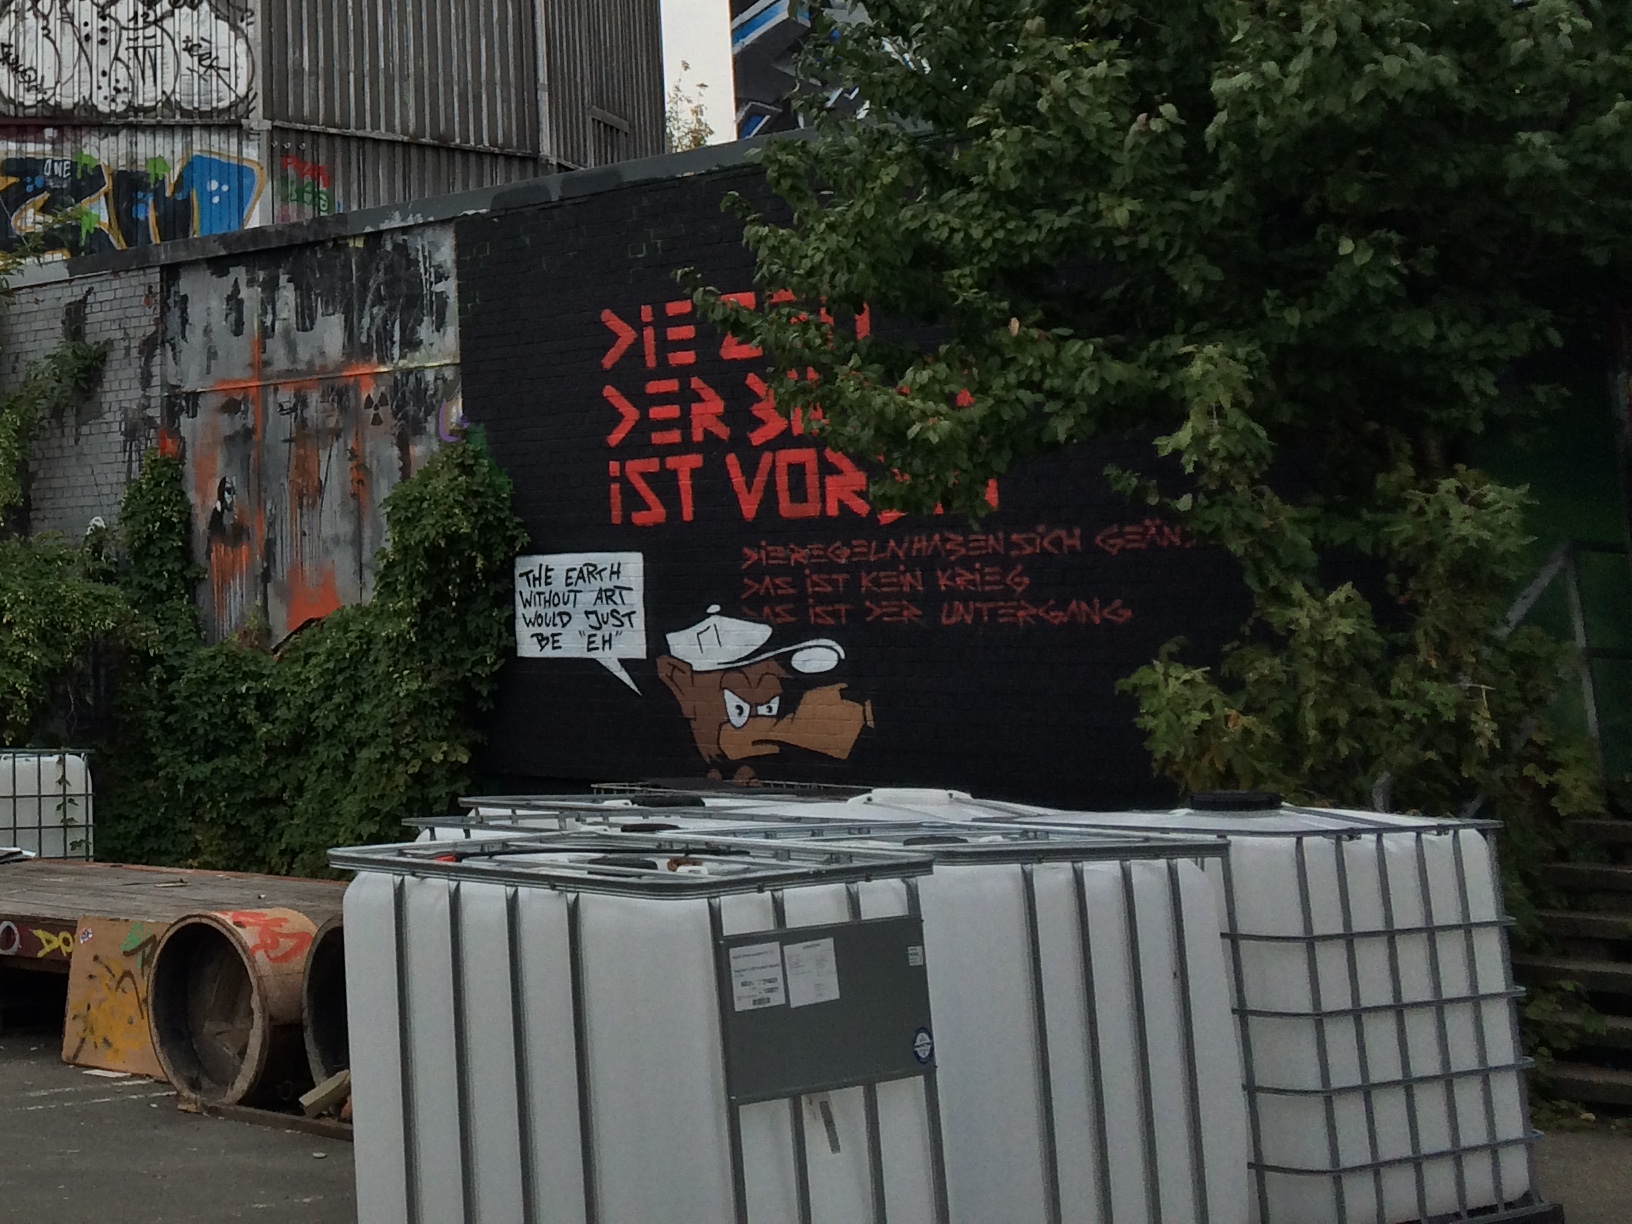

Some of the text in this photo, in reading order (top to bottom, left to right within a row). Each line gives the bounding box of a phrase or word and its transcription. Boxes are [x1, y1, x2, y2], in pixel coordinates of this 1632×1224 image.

[519, 561, 621, 588] THE EARTH
[519, 585, 634, 609] WITHOUT ART
[521, 609, 637, 630] WOULD JUST
[941, 596, 1133, 626] UNTERGANG
[530, 629, 623, 653] BE "EH"
